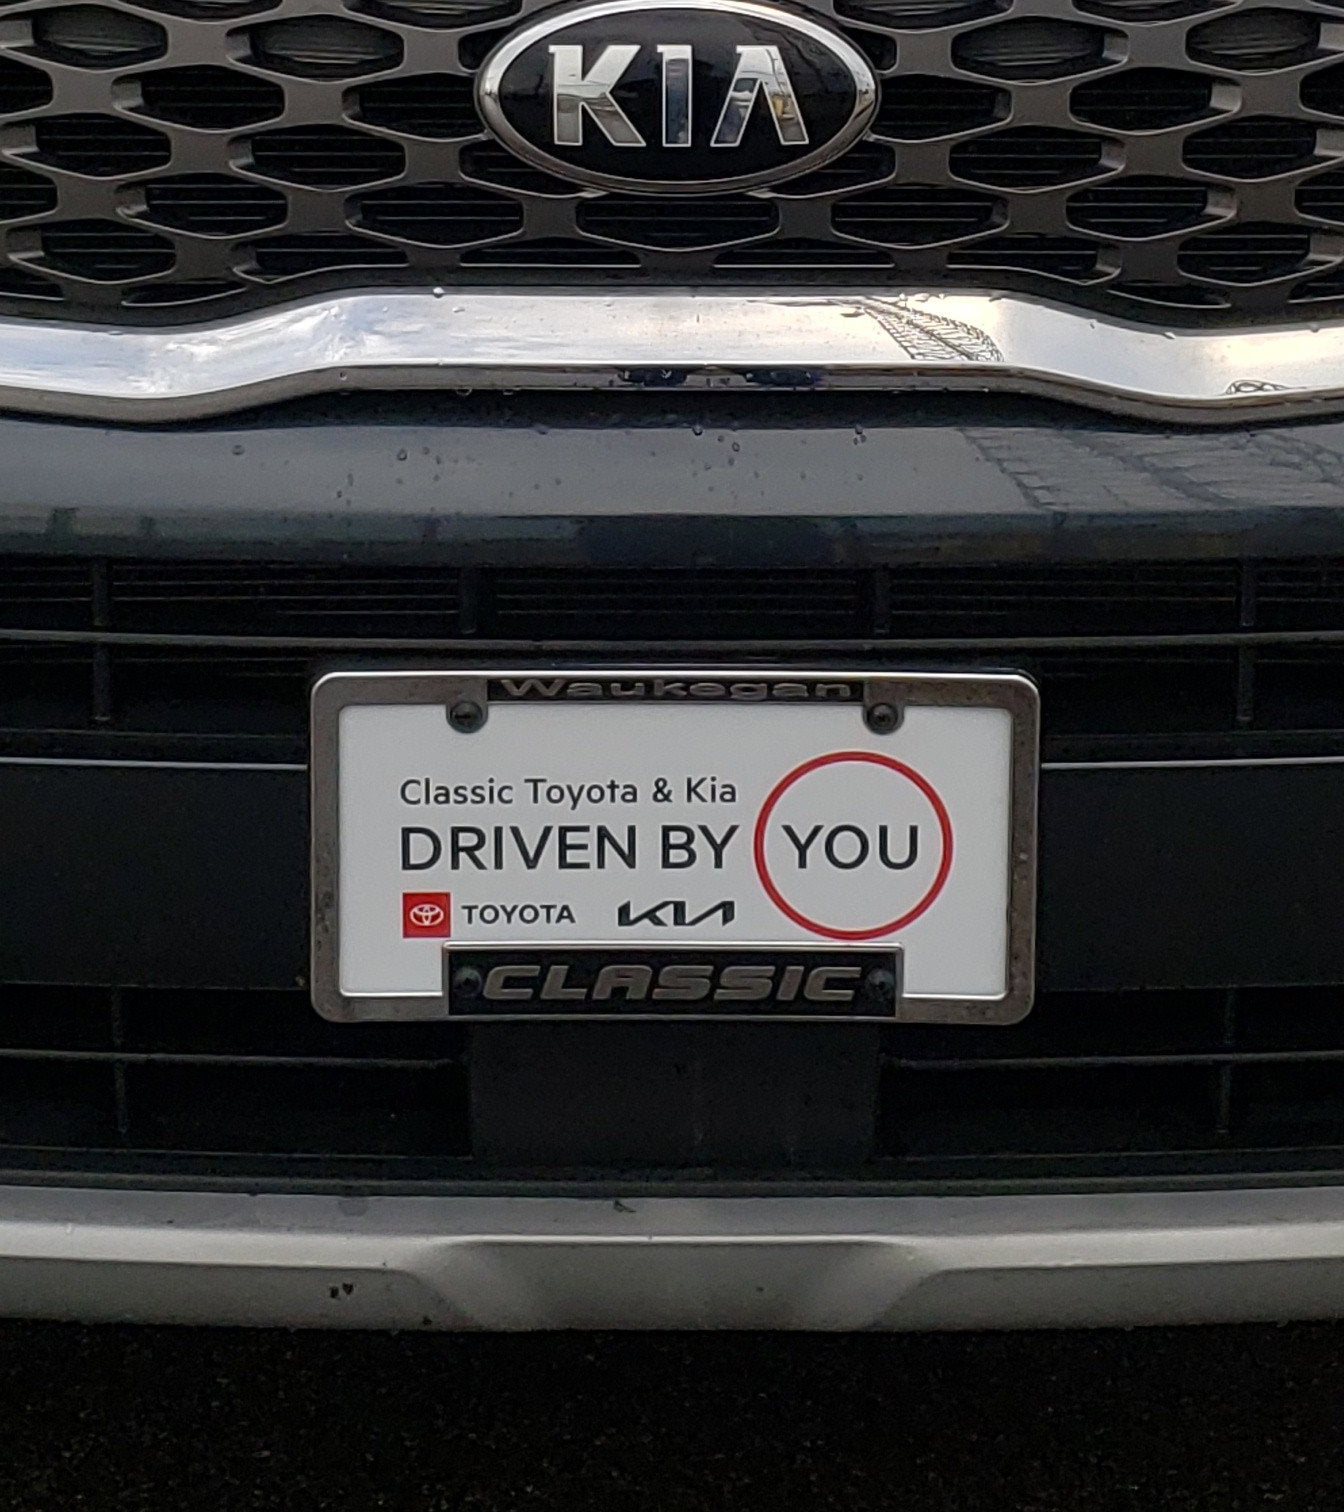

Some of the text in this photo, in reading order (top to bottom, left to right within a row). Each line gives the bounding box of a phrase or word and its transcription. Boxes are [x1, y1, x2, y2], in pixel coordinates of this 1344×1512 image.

[548, 44, 810, 148] KIA
[500, 677, 851, 700] Waukegan
[399, 777, 737, 810] Classic Toyota & Kia
[401, 824, 919, 871] DRIVEN BY YOU
[461, 905, 576, 925] TOYOTA
[482, 965, 862, 1001] CLASSIC
